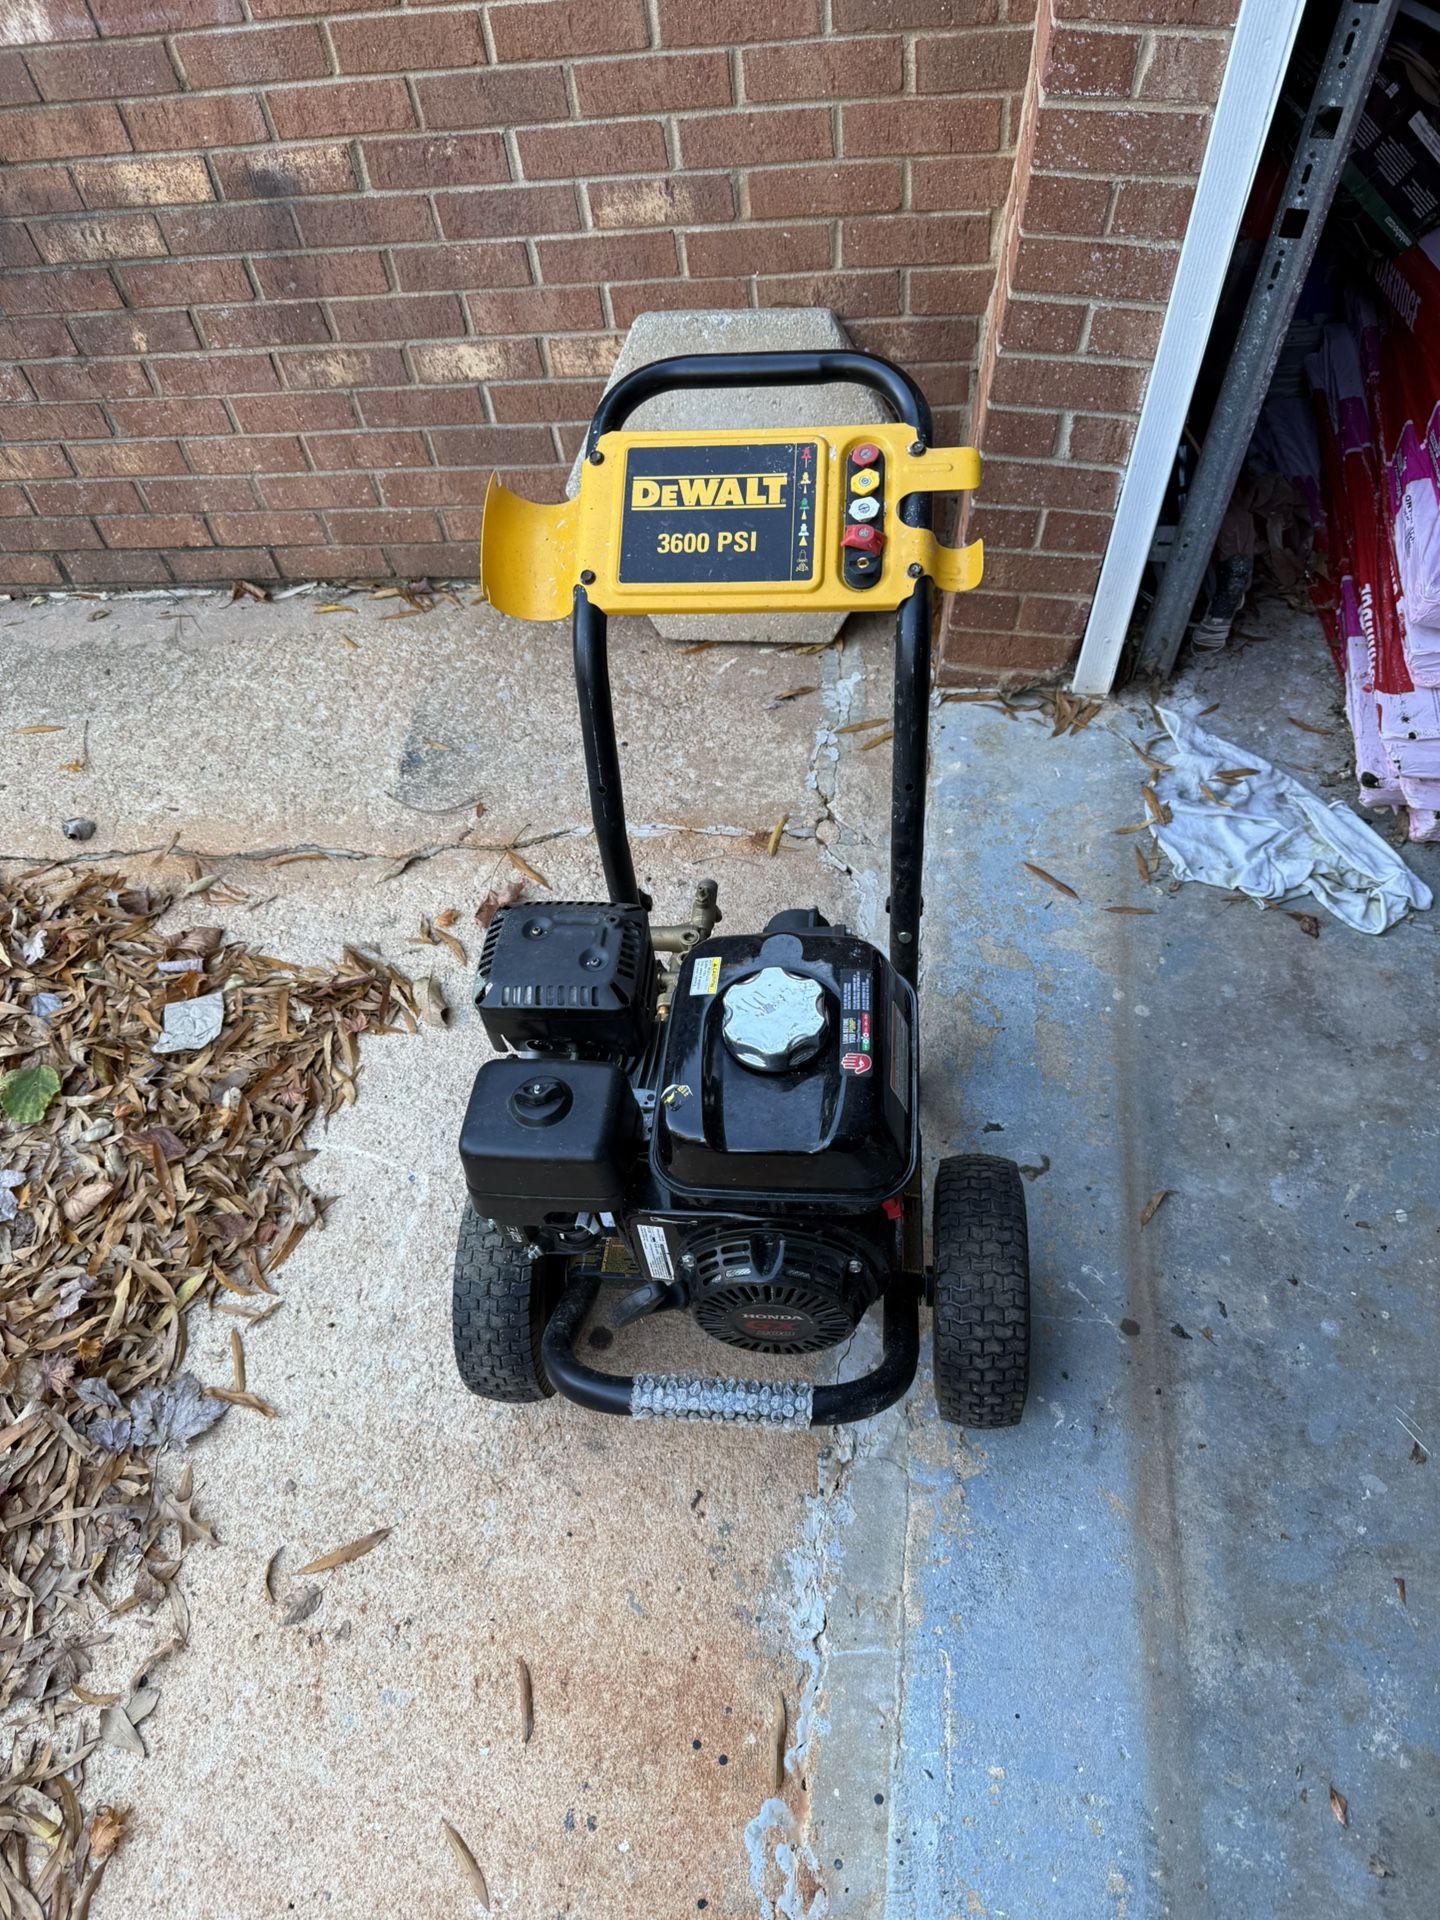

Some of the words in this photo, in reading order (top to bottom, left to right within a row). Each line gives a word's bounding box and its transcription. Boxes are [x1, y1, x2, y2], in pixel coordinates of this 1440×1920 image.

[631, 477, 787, 507] DEWALT
[656, 532, 710, 554] 3600
[717, 531, 757, 553] PSI
[742, 1313, 804, 1321] HONDA
[745, 1320, 797, 1331] GX
